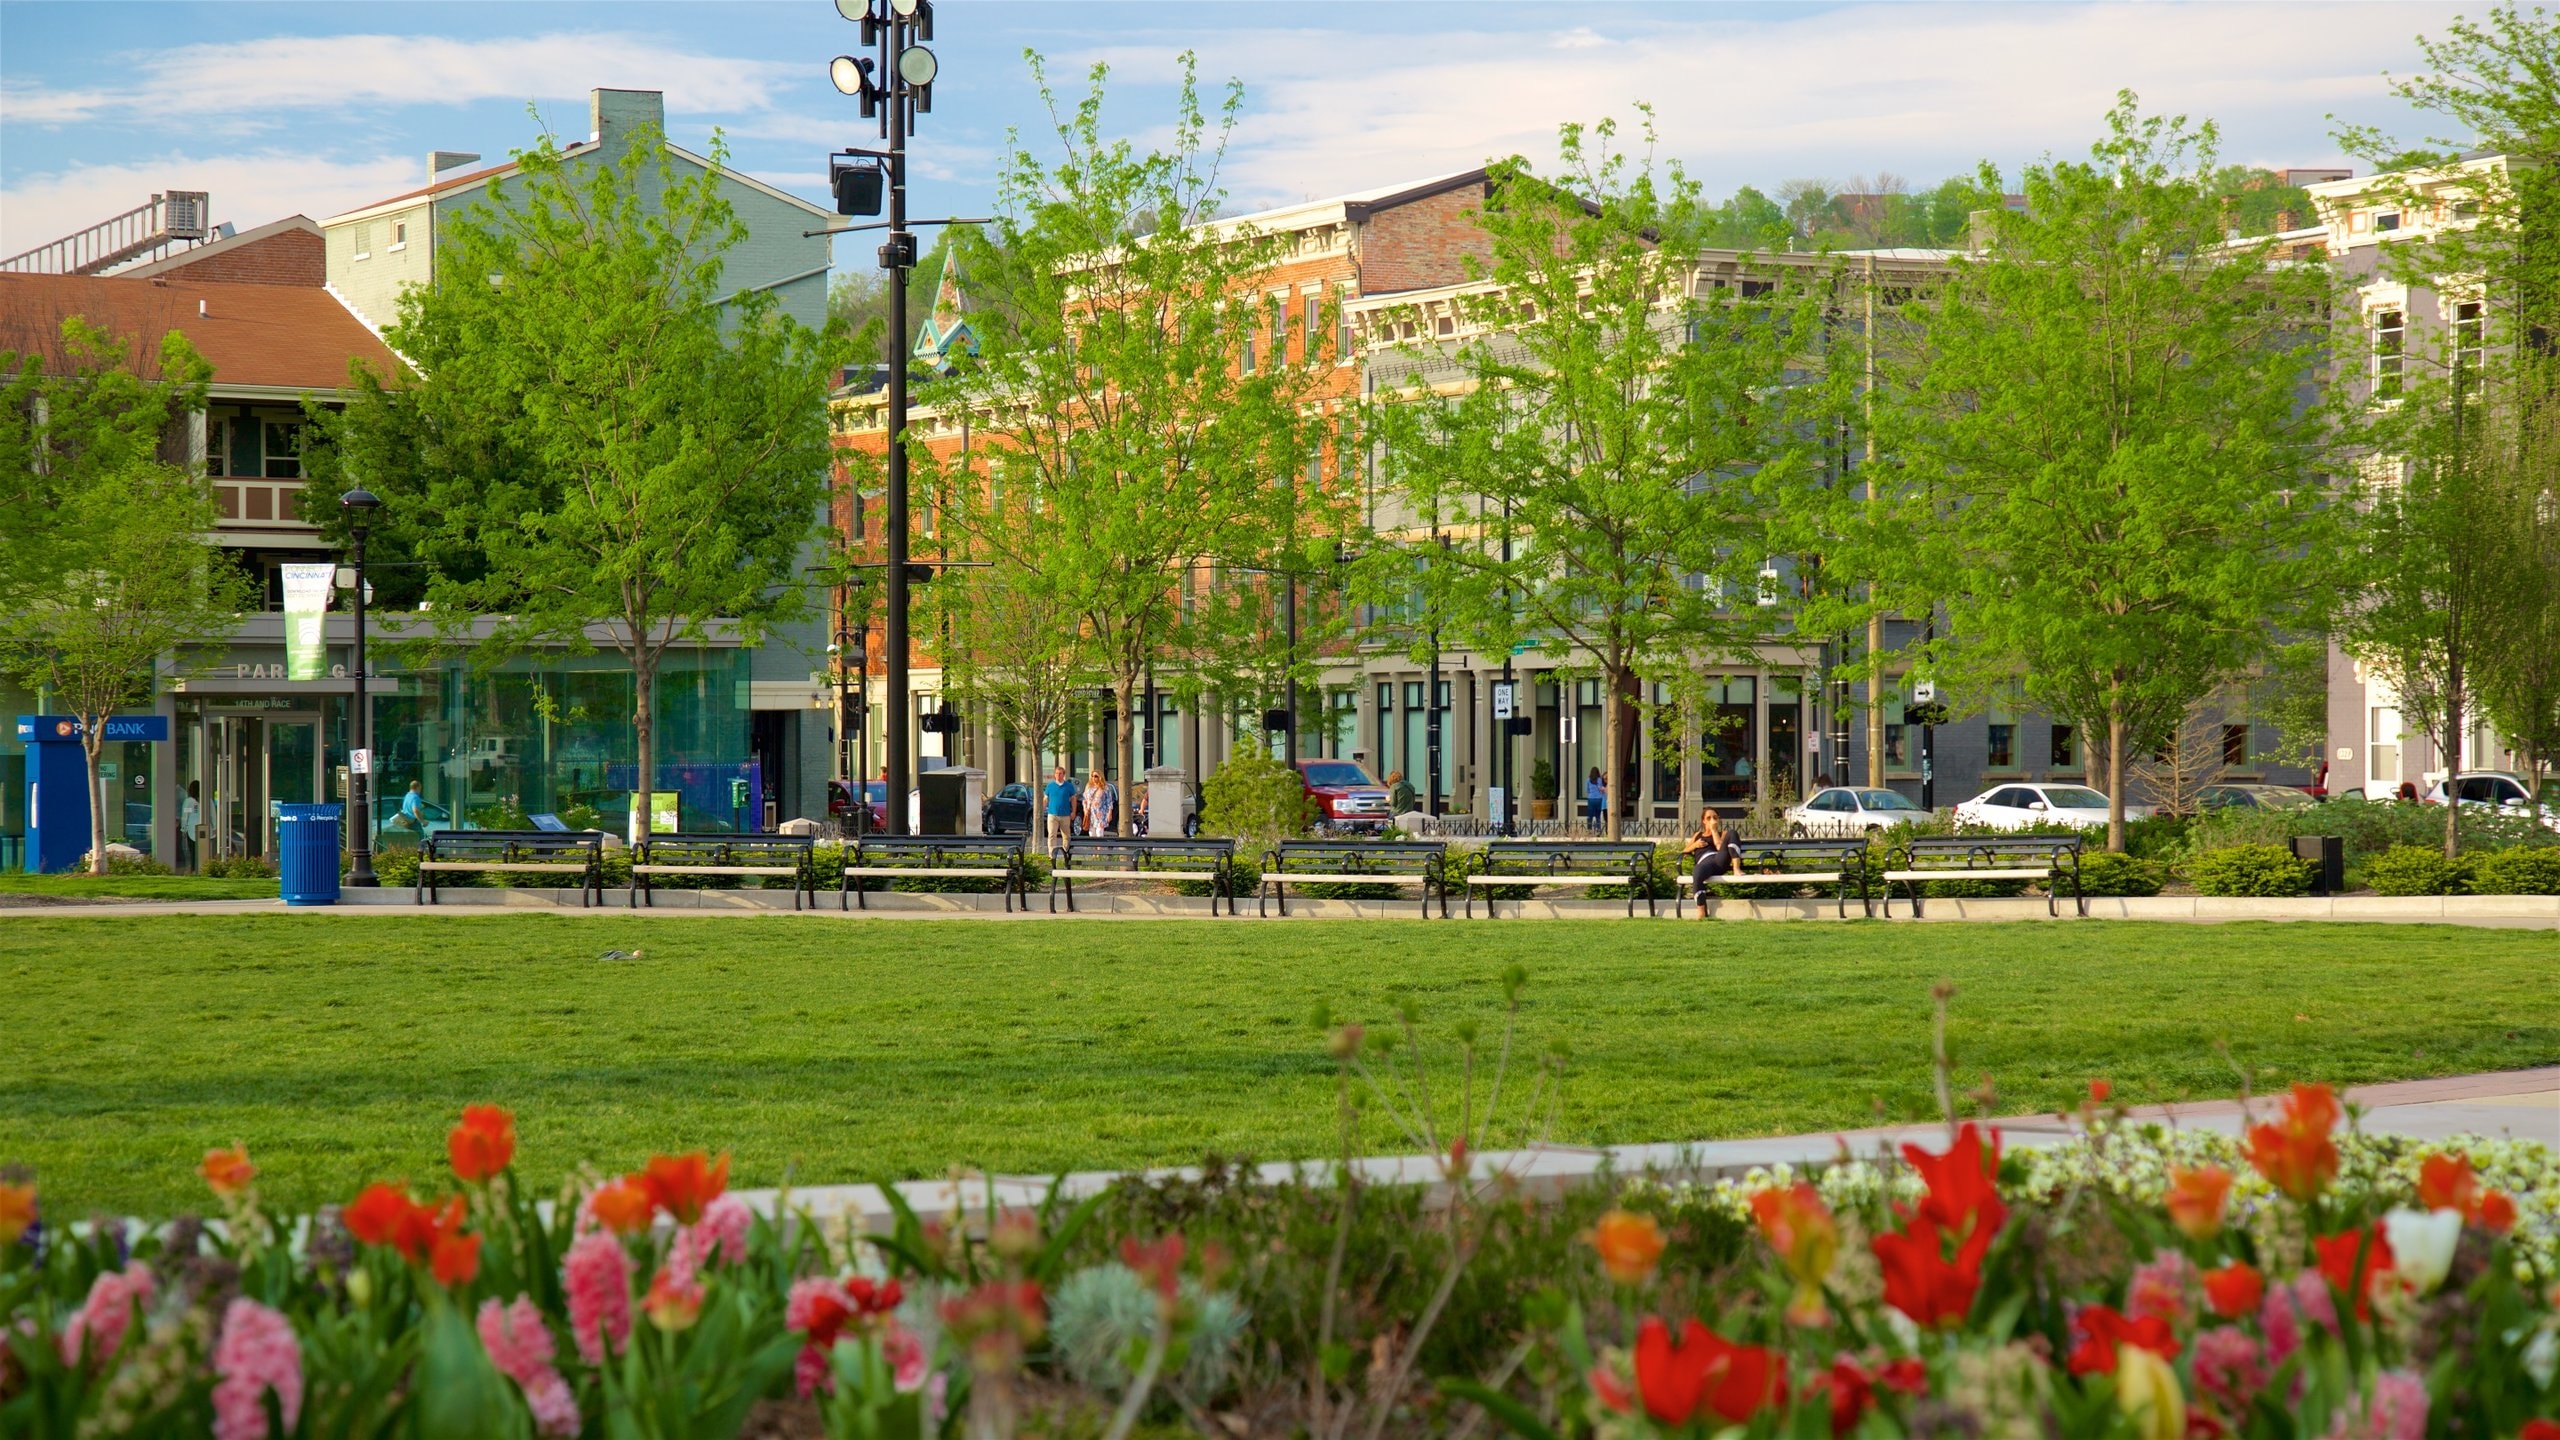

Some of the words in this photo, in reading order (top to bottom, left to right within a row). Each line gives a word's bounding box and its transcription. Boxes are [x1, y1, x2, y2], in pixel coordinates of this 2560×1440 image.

[237, 663, 345, 679] PARG
[1498, 688, 1509, 696] ONE
[235, 700, 253, 708] 14TH
[254, 700, 270, 708] AND
[271, 699, 291, 708] RACE
[107, 723, 145, 734] BANK
